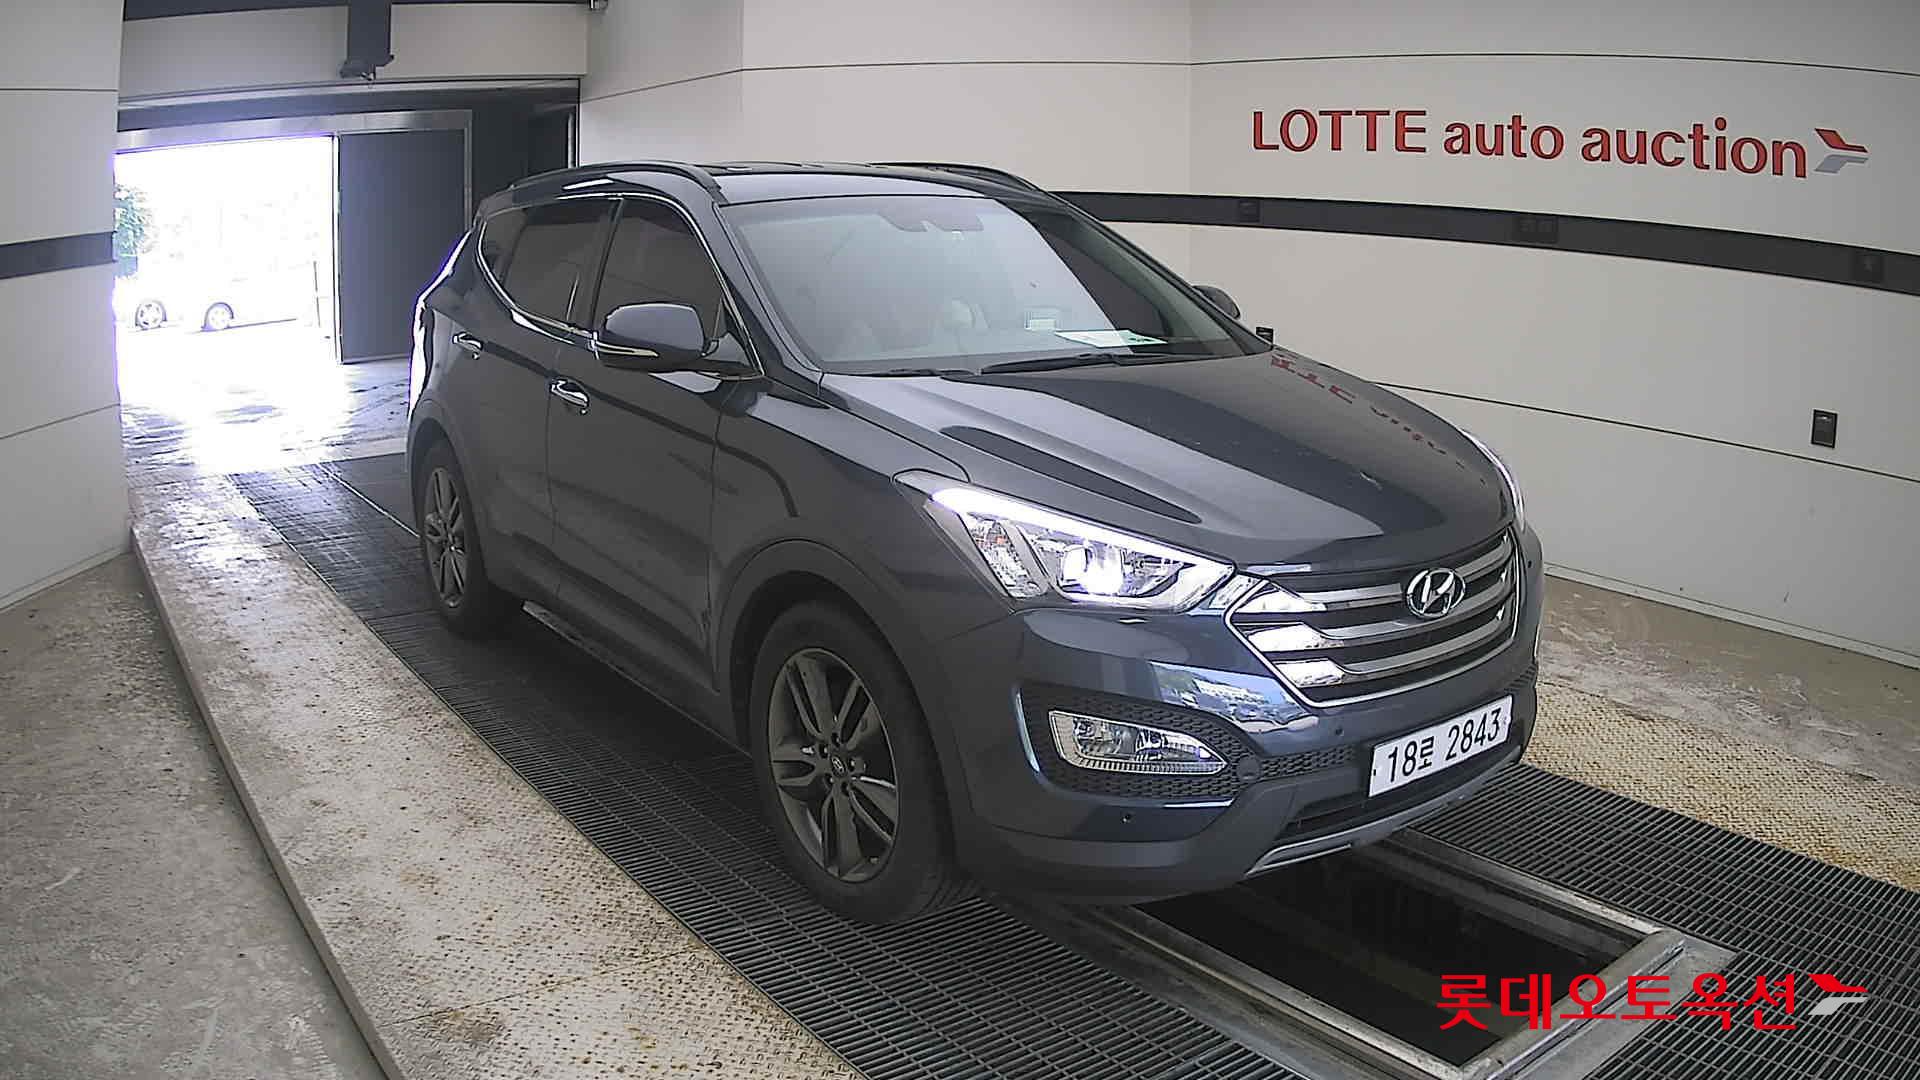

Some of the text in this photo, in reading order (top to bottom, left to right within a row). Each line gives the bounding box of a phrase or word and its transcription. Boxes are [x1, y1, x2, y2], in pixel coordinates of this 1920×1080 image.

[1252, 109, 1808, 178] LOTTE auto auction
[1387, 707, 1502, 783] 18로 2843
